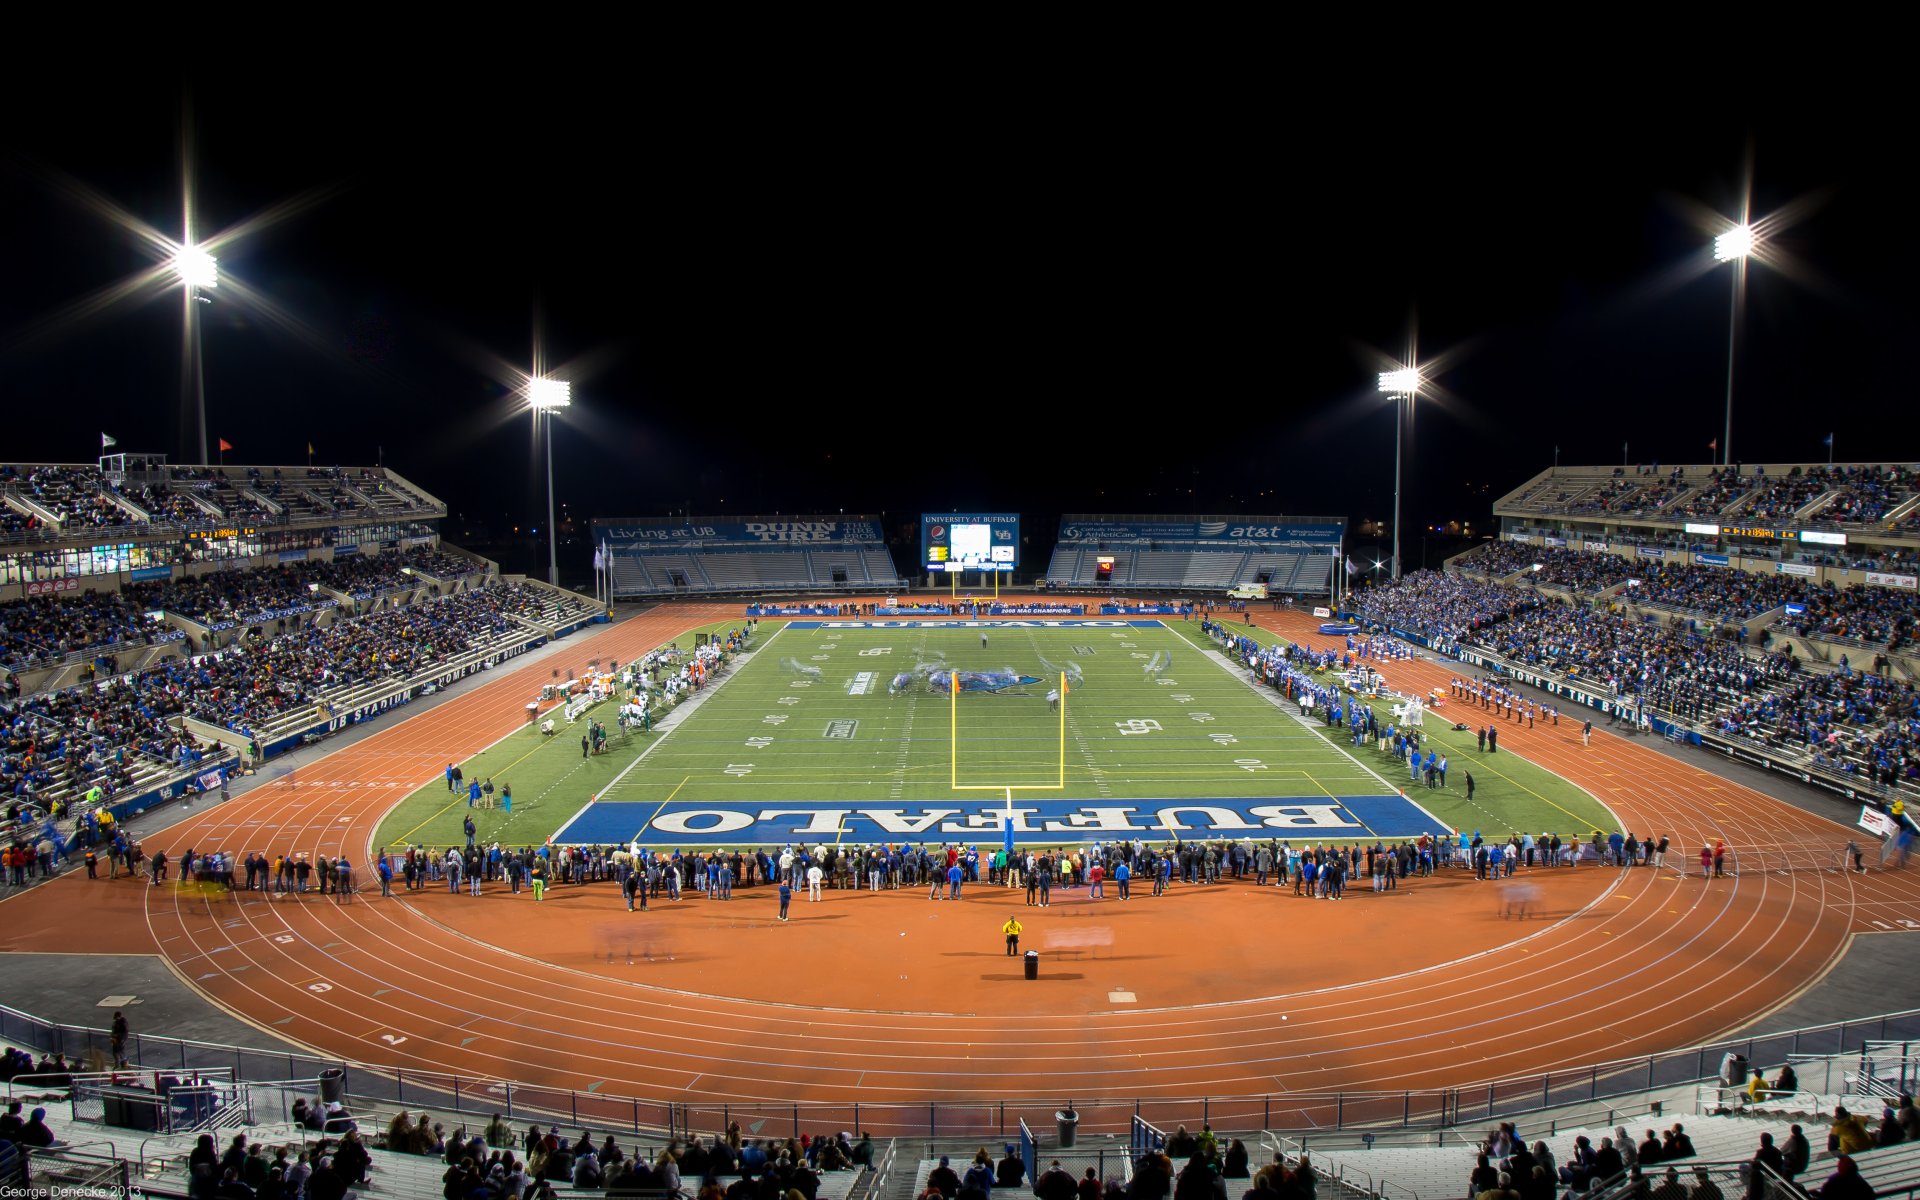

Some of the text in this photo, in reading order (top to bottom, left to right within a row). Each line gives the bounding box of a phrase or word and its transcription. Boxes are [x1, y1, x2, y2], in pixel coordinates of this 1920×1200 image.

[745, 522, 836, 532] DUNN
[1230, 526, 1281, 538] at&t
[608, 527, 716, 540] Living at UB
[754, 531, 830, 541] TIRE
[470, 662, 481, 674] OF
[504, 644, 527, 660] BULLS
[1442, 644, 1482, 666] STDIUM
[1510, 668, 1541, 688] HOME
[1548, 683, 1562, 695] OF
[1569, 690, 1594, 707] THE
[329, 690, 412, 732] UB STADIUM
[1188, 712, 1215, 721] 30
[762, 715, 789, 723] 30
[1115, 719, 1163, 736] UB
[745, 737, 774, 746] 20
[1208, 734, 1240, 743] 20
[723, 763, 755, 774] 10
[1234, 759, 1268, 770] 10
[159, 787, 172, 799] UB
[650, 805, 1363, 834] BUFFALO
[1872, 920, 1894, 929] 1
[274, 935, 294, 944] 5
[308, 982, 332, 993] 6
[381, 1034, 408, 1045] 7
